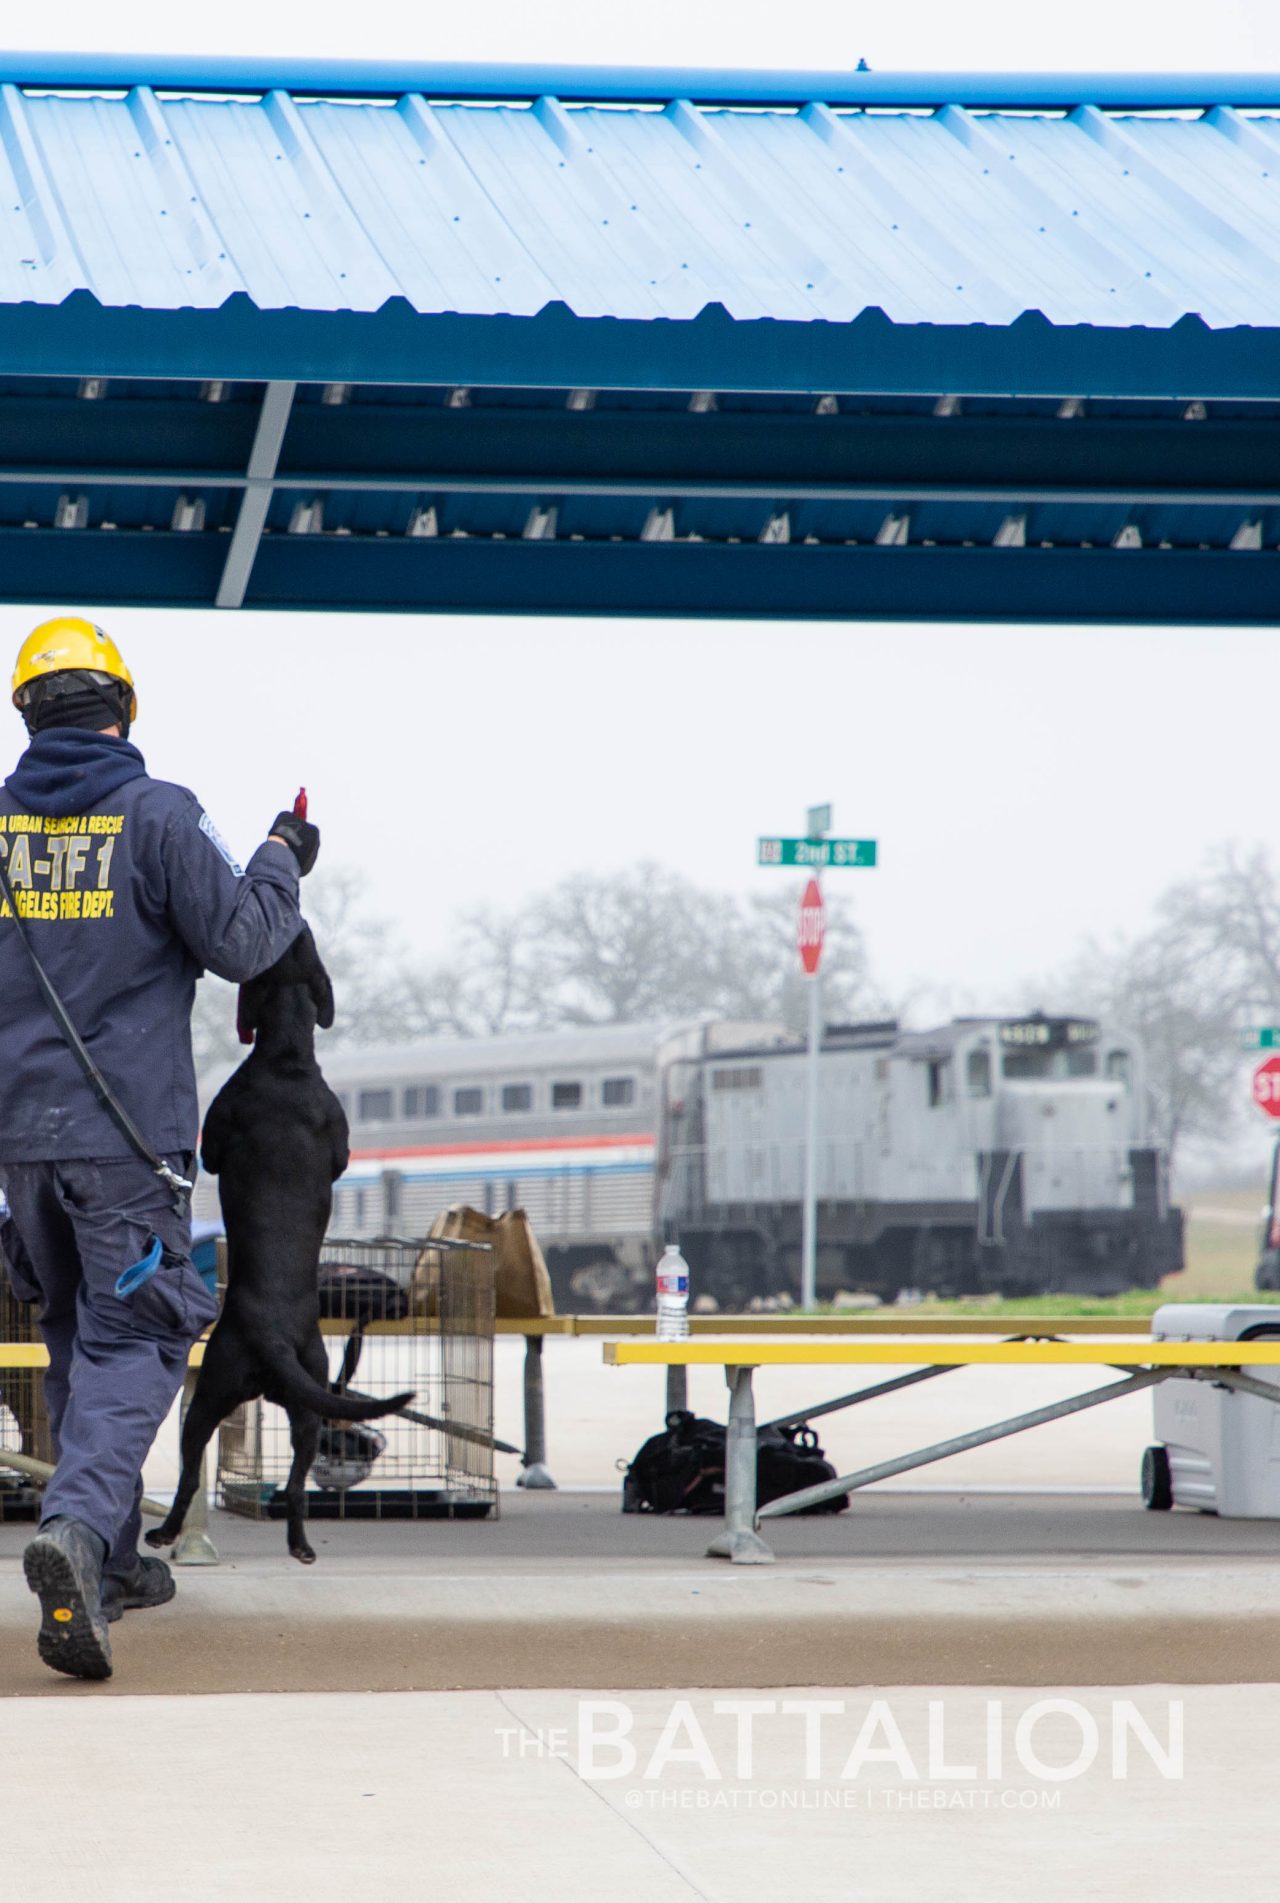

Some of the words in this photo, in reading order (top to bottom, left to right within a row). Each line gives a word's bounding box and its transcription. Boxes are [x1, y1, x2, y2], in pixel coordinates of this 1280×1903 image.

[8, 814, 43, 833] URBAN
[79, 815, 87, 834] &
[88, 815, 125, 834] RESCUE
[59, 891, 81, 920] FIRE
[82, 890, 114, 919] DEPT.
